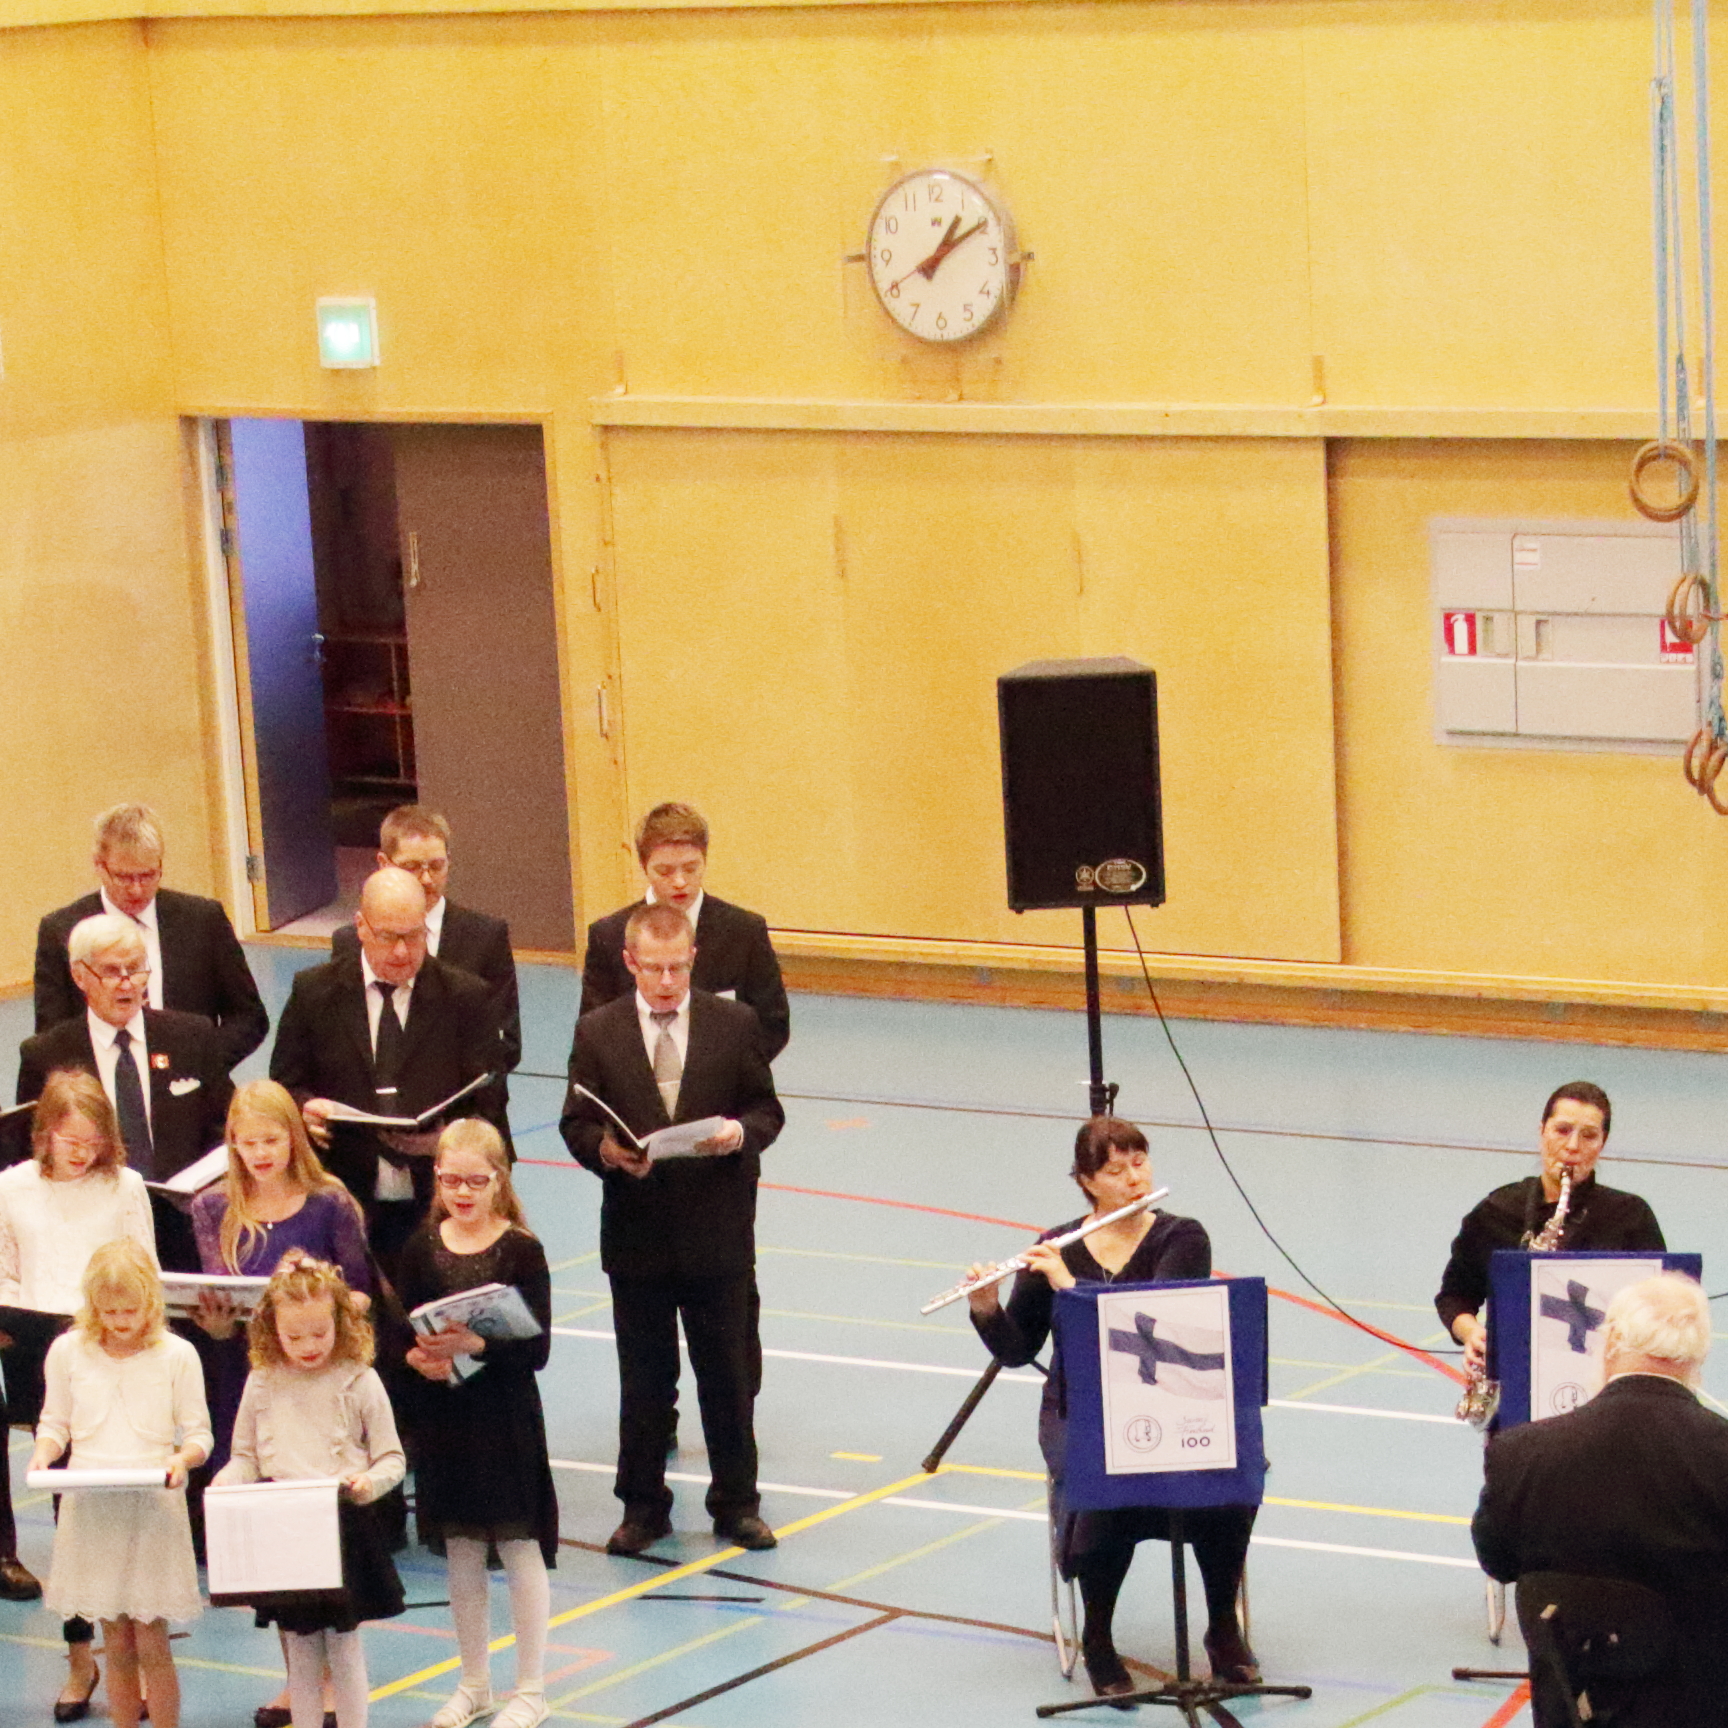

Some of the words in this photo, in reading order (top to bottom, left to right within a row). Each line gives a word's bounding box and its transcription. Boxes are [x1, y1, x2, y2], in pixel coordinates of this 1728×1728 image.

[904, 192, 917, 212] 11
[928, 183, 944, 203] 12
[884, 215, 899, 235] 10
[978, 216, 988, 235] 2
[880, 248, 892, 267] 9
[988, 247, 999, 267] 3
[889, 281, 901, 299] 8
[978, 280, 991, 299] 4
[909, 302, 920, 321] 7
[935, 311, 948, 331] 6
[963, 303, 974, 322] 5
[1181, 1436, 1211, 1448] 100
